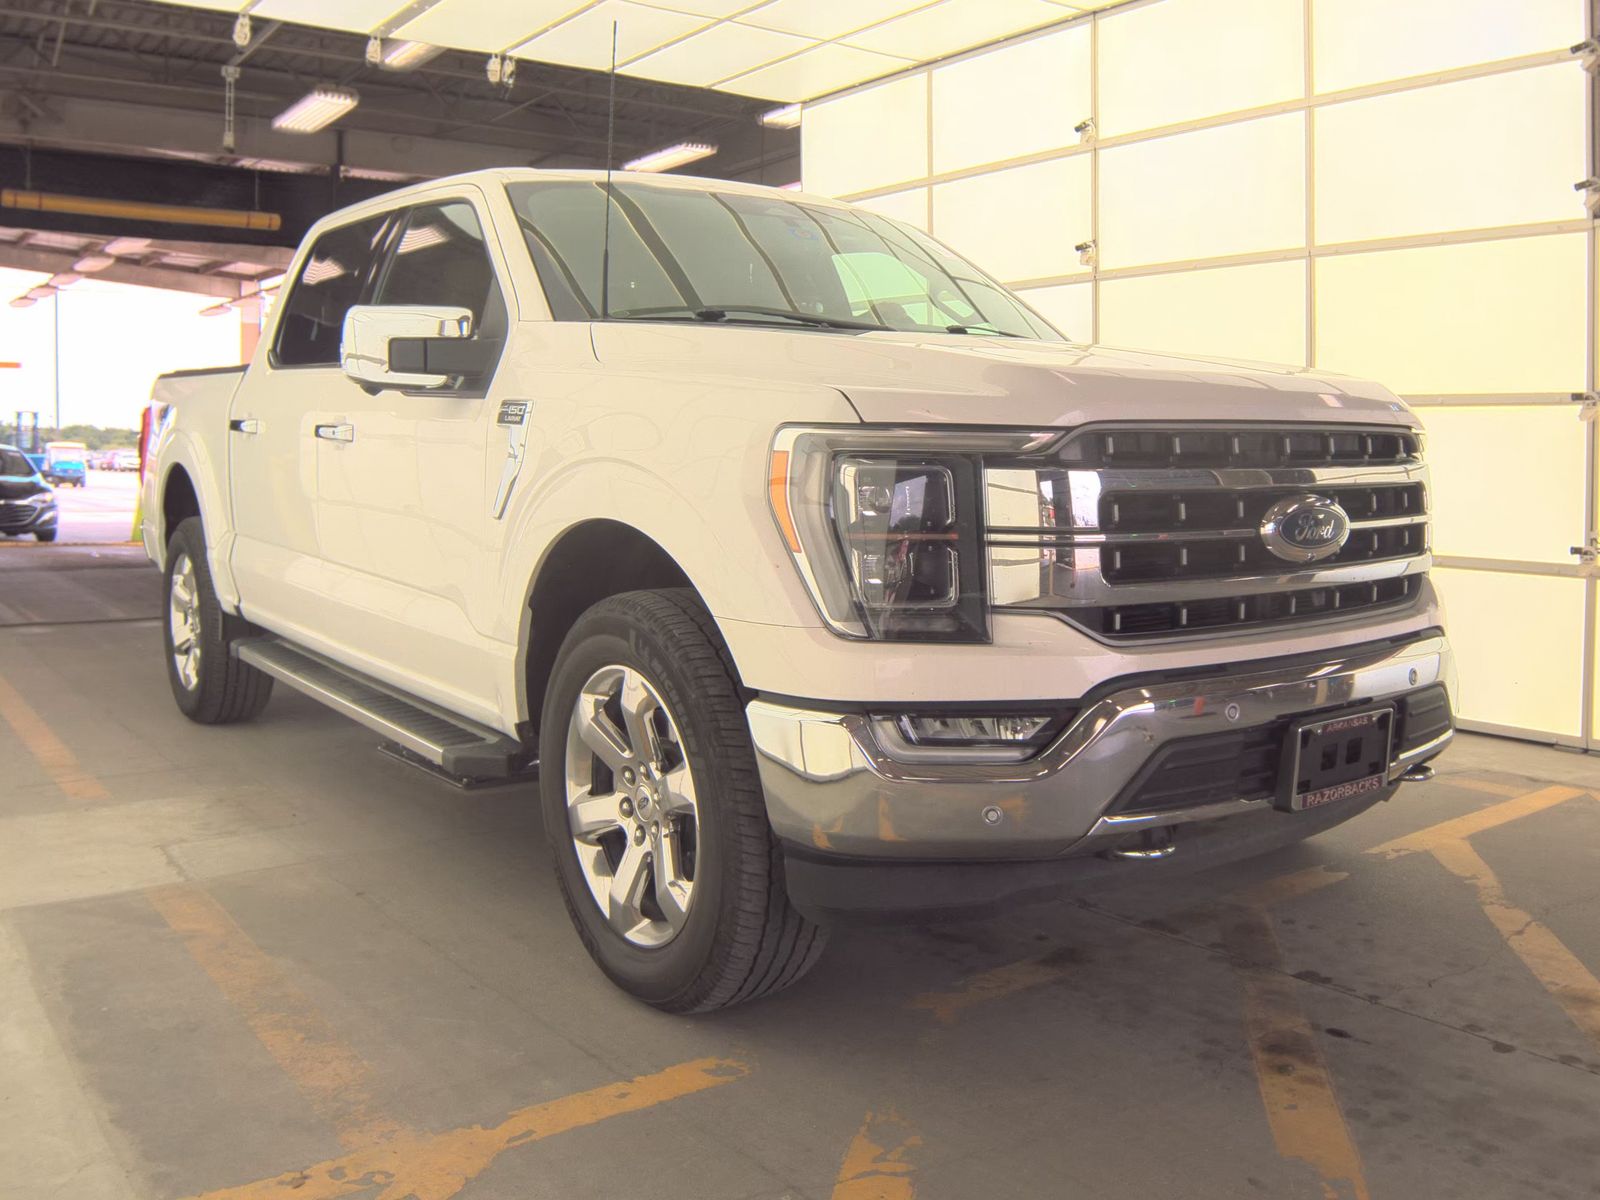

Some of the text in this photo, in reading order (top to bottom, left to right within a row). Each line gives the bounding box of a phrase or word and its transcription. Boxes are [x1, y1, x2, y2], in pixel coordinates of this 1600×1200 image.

[1295, 513, 1335, 541] Ford
[1325, 716, 1370, 733] ARKANSAS
[1306, 778, 1380, 806] RAZORBACKS
